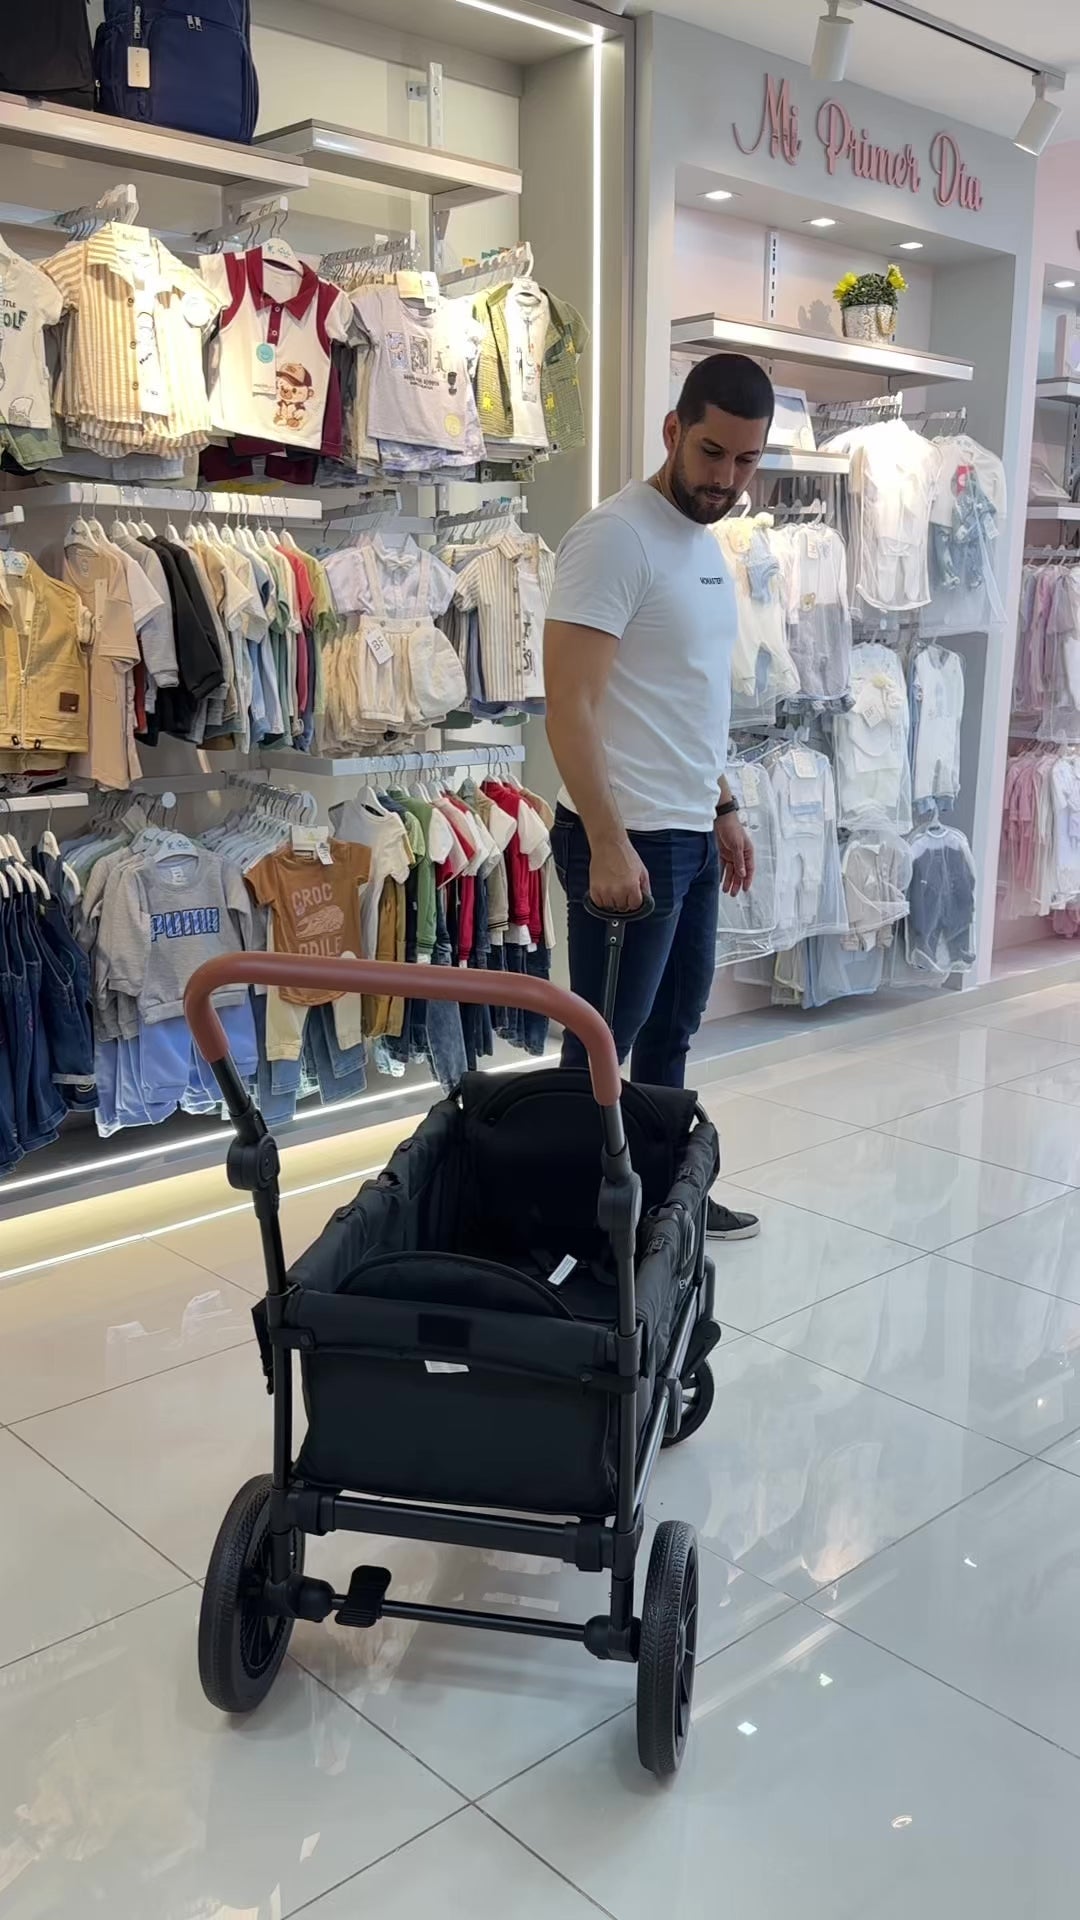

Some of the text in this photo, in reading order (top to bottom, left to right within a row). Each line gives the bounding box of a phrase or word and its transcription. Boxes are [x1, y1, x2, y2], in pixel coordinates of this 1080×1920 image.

[732, 72, 802, 166] Mi
[816, 99, 920, 192] Primer
[291, 882, 334, 911] CROC
[150, 906, 220, 942] PUMA
